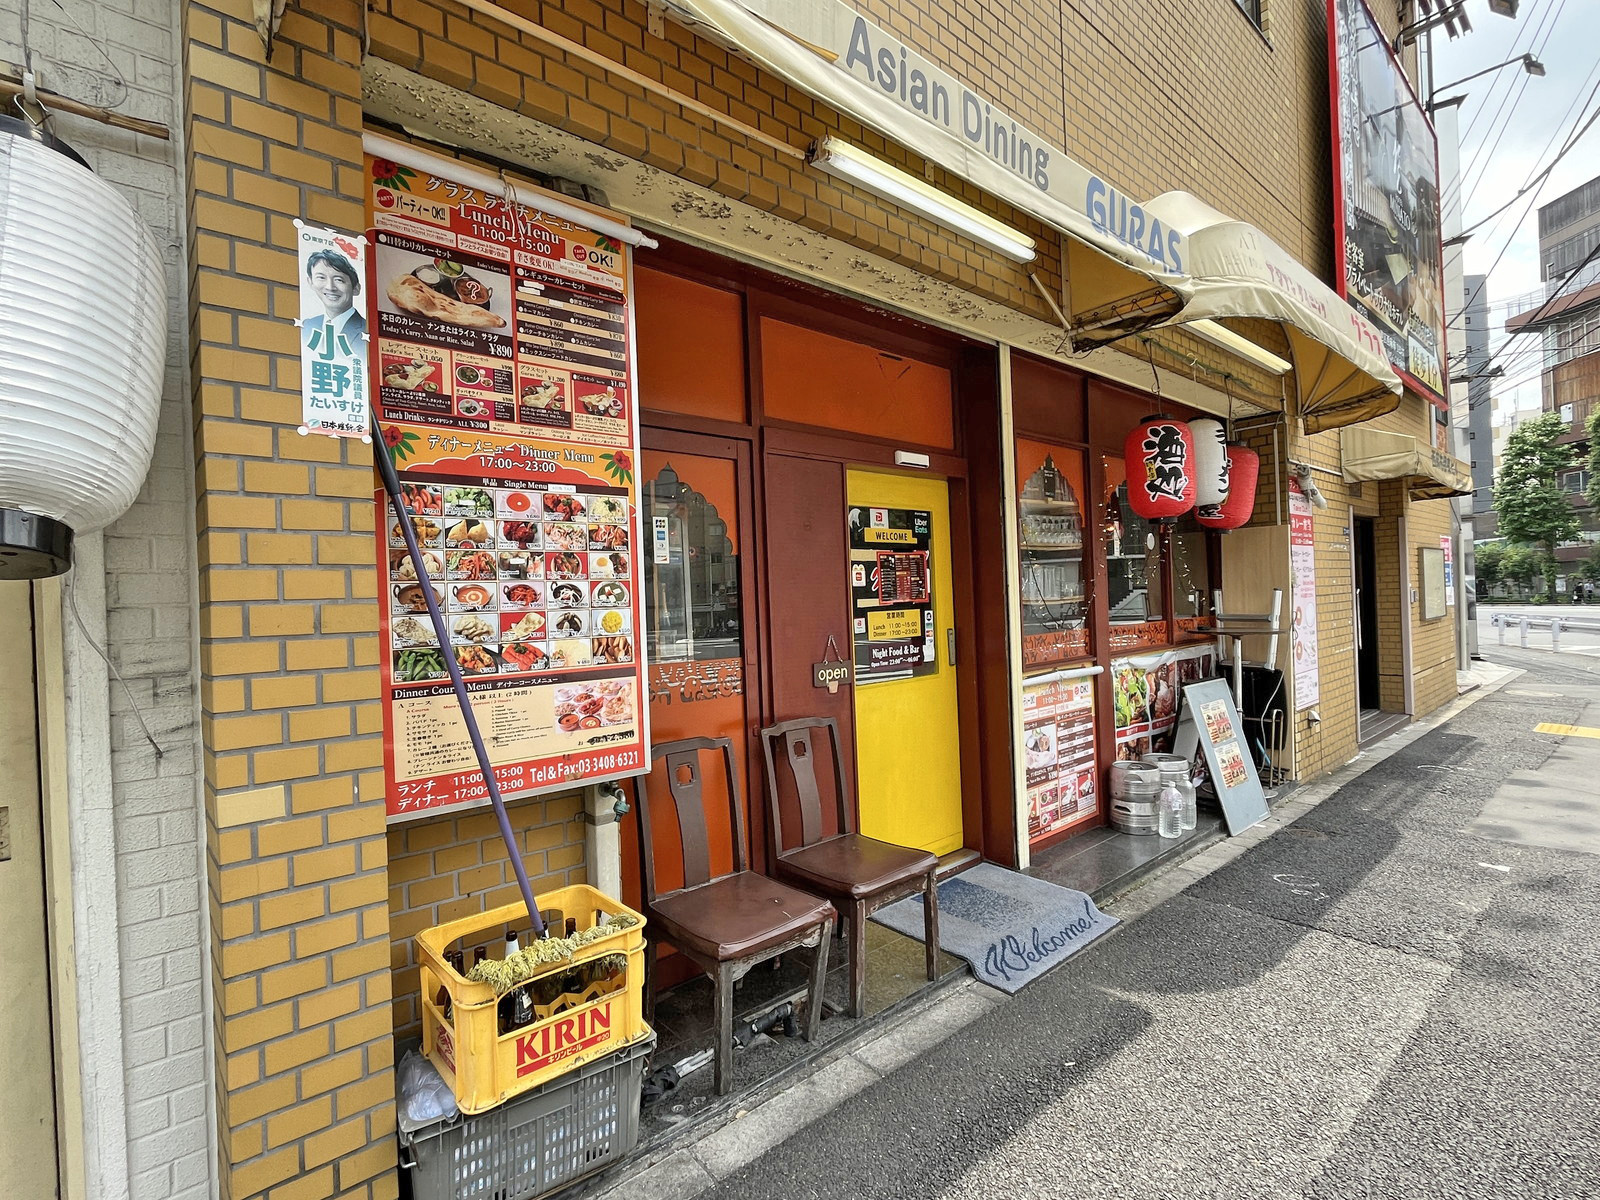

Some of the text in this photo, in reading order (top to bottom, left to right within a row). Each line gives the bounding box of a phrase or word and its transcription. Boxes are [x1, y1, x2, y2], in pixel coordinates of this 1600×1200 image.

[846, 16, 1050, 192] Asian Dining
[459, 203, 511, 231] Lunch
[518, 220, 560, 245] Menu
[1085, 175, 1184, 275] GURAS
[588, 250, 613, 268] OK!
[382, 323, 404, 336] Today's
[488, 343, 513, 358] ¥890
[307, 323, 353, 398] 小野
[310, 395, 364, 414] たいすけ
[385, 409, 425, 423] Lunch Drinks:
[428, 435, 515, 456] ディナーメニュー
[519, 444, 594, 463] Dinner Menu
[479, 456, 556, 473] 17:00〜23:00
[504, 479, 548, 490] Single Menu
[914, 518, 927, 526] Uber
[914, 526, 927, 534] Eats
[875, 531, 908, 541] WELCOME
[873, 623, 886, 631] Lunch
[872, 644, 920, 660] Night Food & Bar
[818, 665, 848, 683] open
[394, 688, 429, 700] Dinner
[467, 682, 492, 692] Menu
[397, 779, 437, 798] ランチ
[397, 793, 449, 811] ディナー
[985, 898, 1099, 981] Welcome!
[516, 1002, 611, 1067] KIRIN
[548, 1044, 583, 1064] キリンビール
